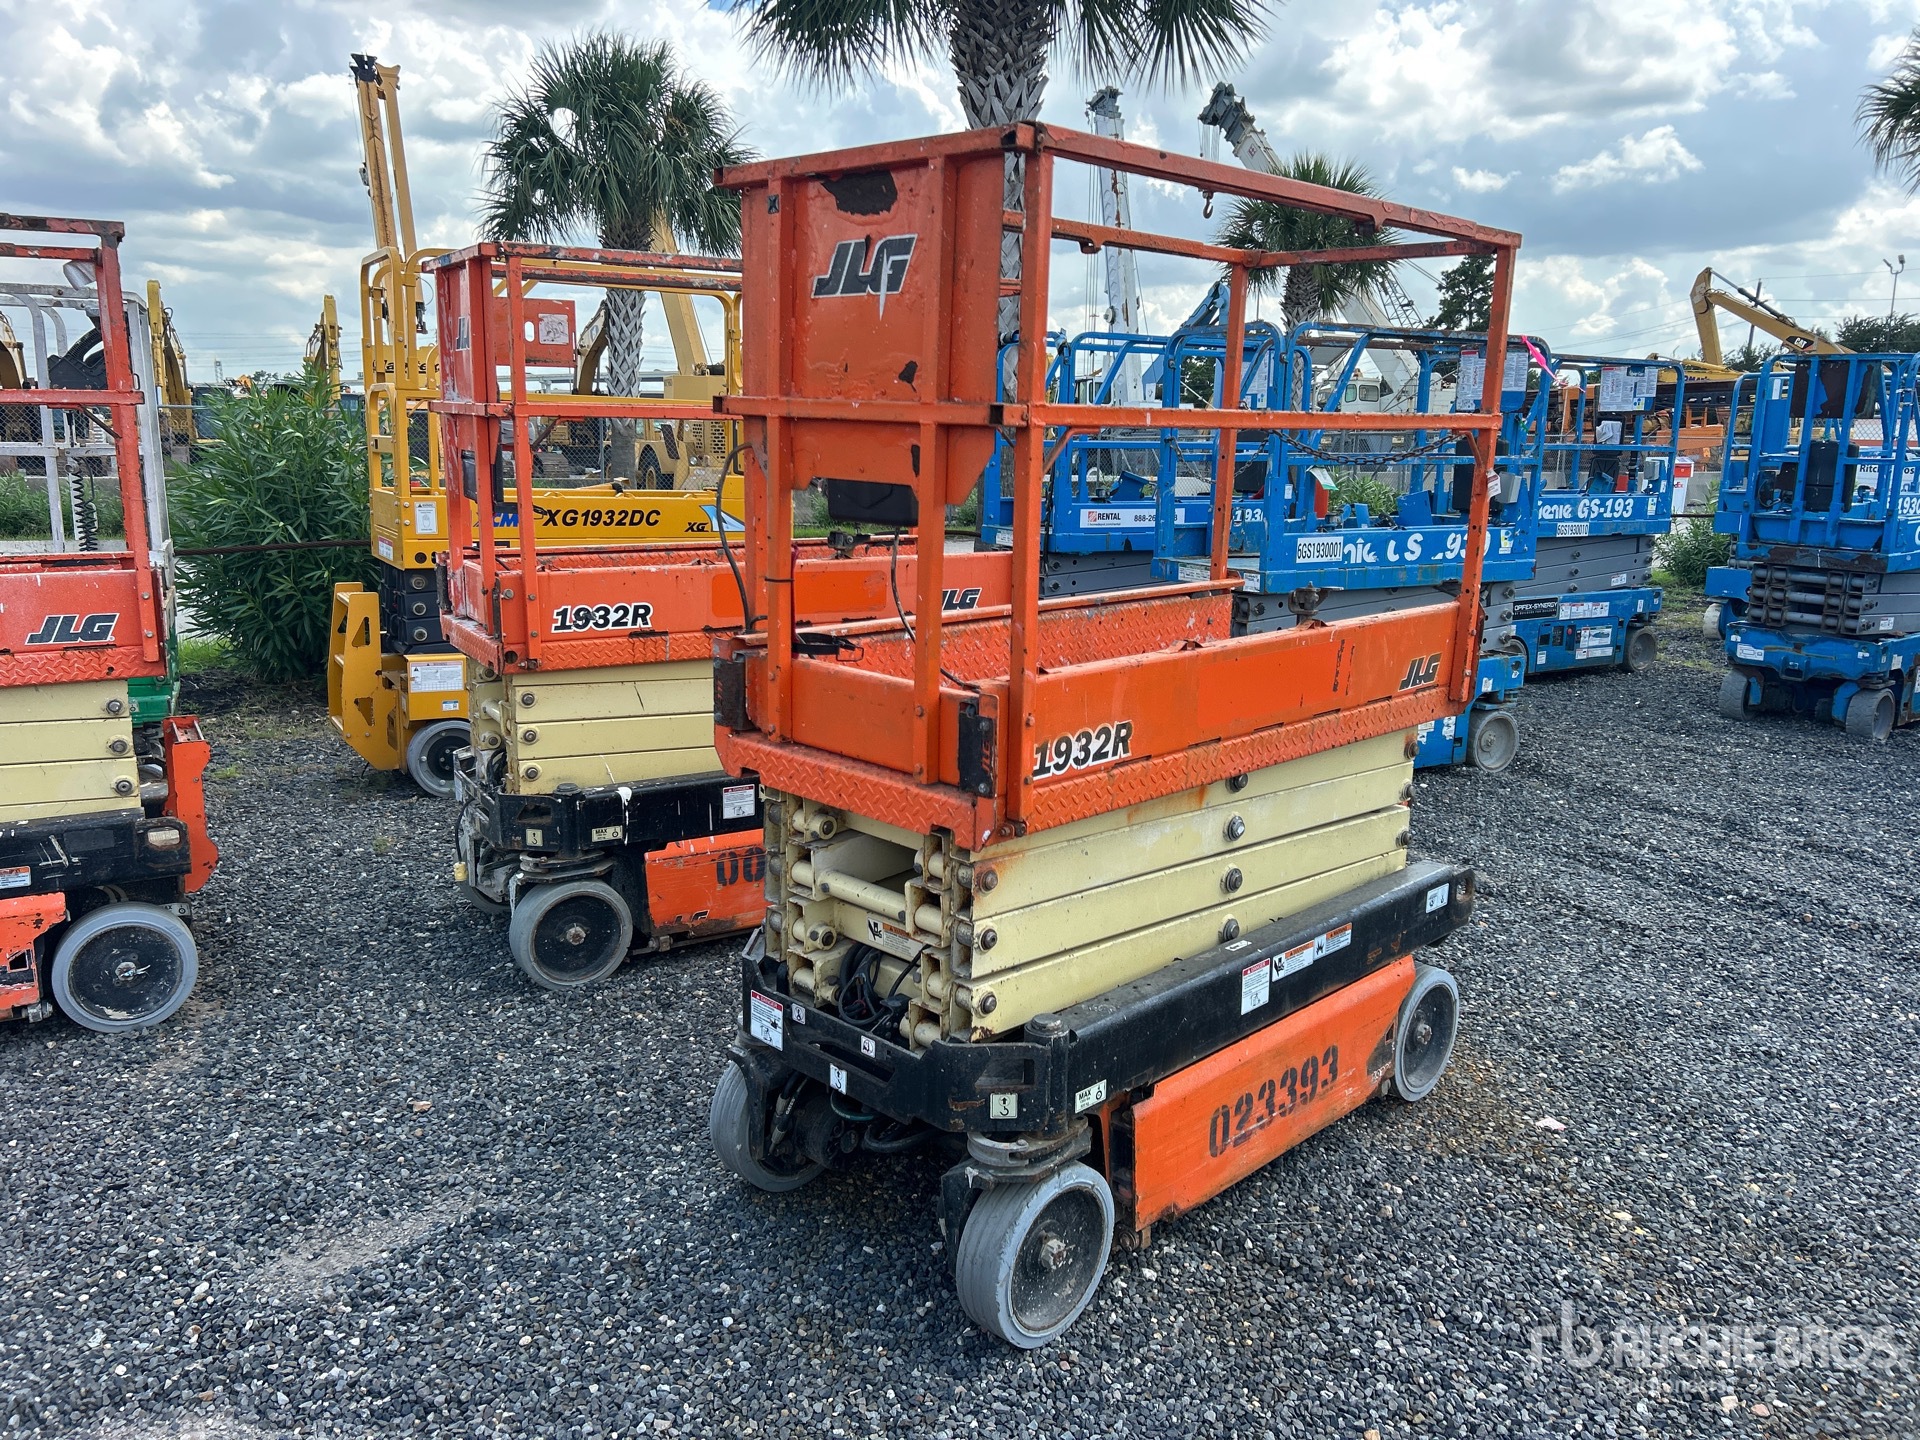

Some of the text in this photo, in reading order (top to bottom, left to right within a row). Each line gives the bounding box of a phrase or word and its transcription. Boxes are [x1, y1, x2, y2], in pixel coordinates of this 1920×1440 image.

[811, 234, 918, 298] JLG
[1794, 337, 1808, 349] CAT
[542, 509, 661, 527] XG1932DC
[1097, 512, 1121, 521] RENTAL
[1538, 498, 1634, 519] enie GS-193
[684, 521, 709, 532] XG
[1297, 541, 1342, 559] 6GS1930001
[551, 602, 653, 633] 1932R
[25, 613, 119, 645] JLG
[1398, 652, 1442, 692] JLG
[1032, 720, 1133, 779] 1932R
[1078, 1088, 1092, 1100] MAX
[1209, 1045, 1339, 1157] 023393
